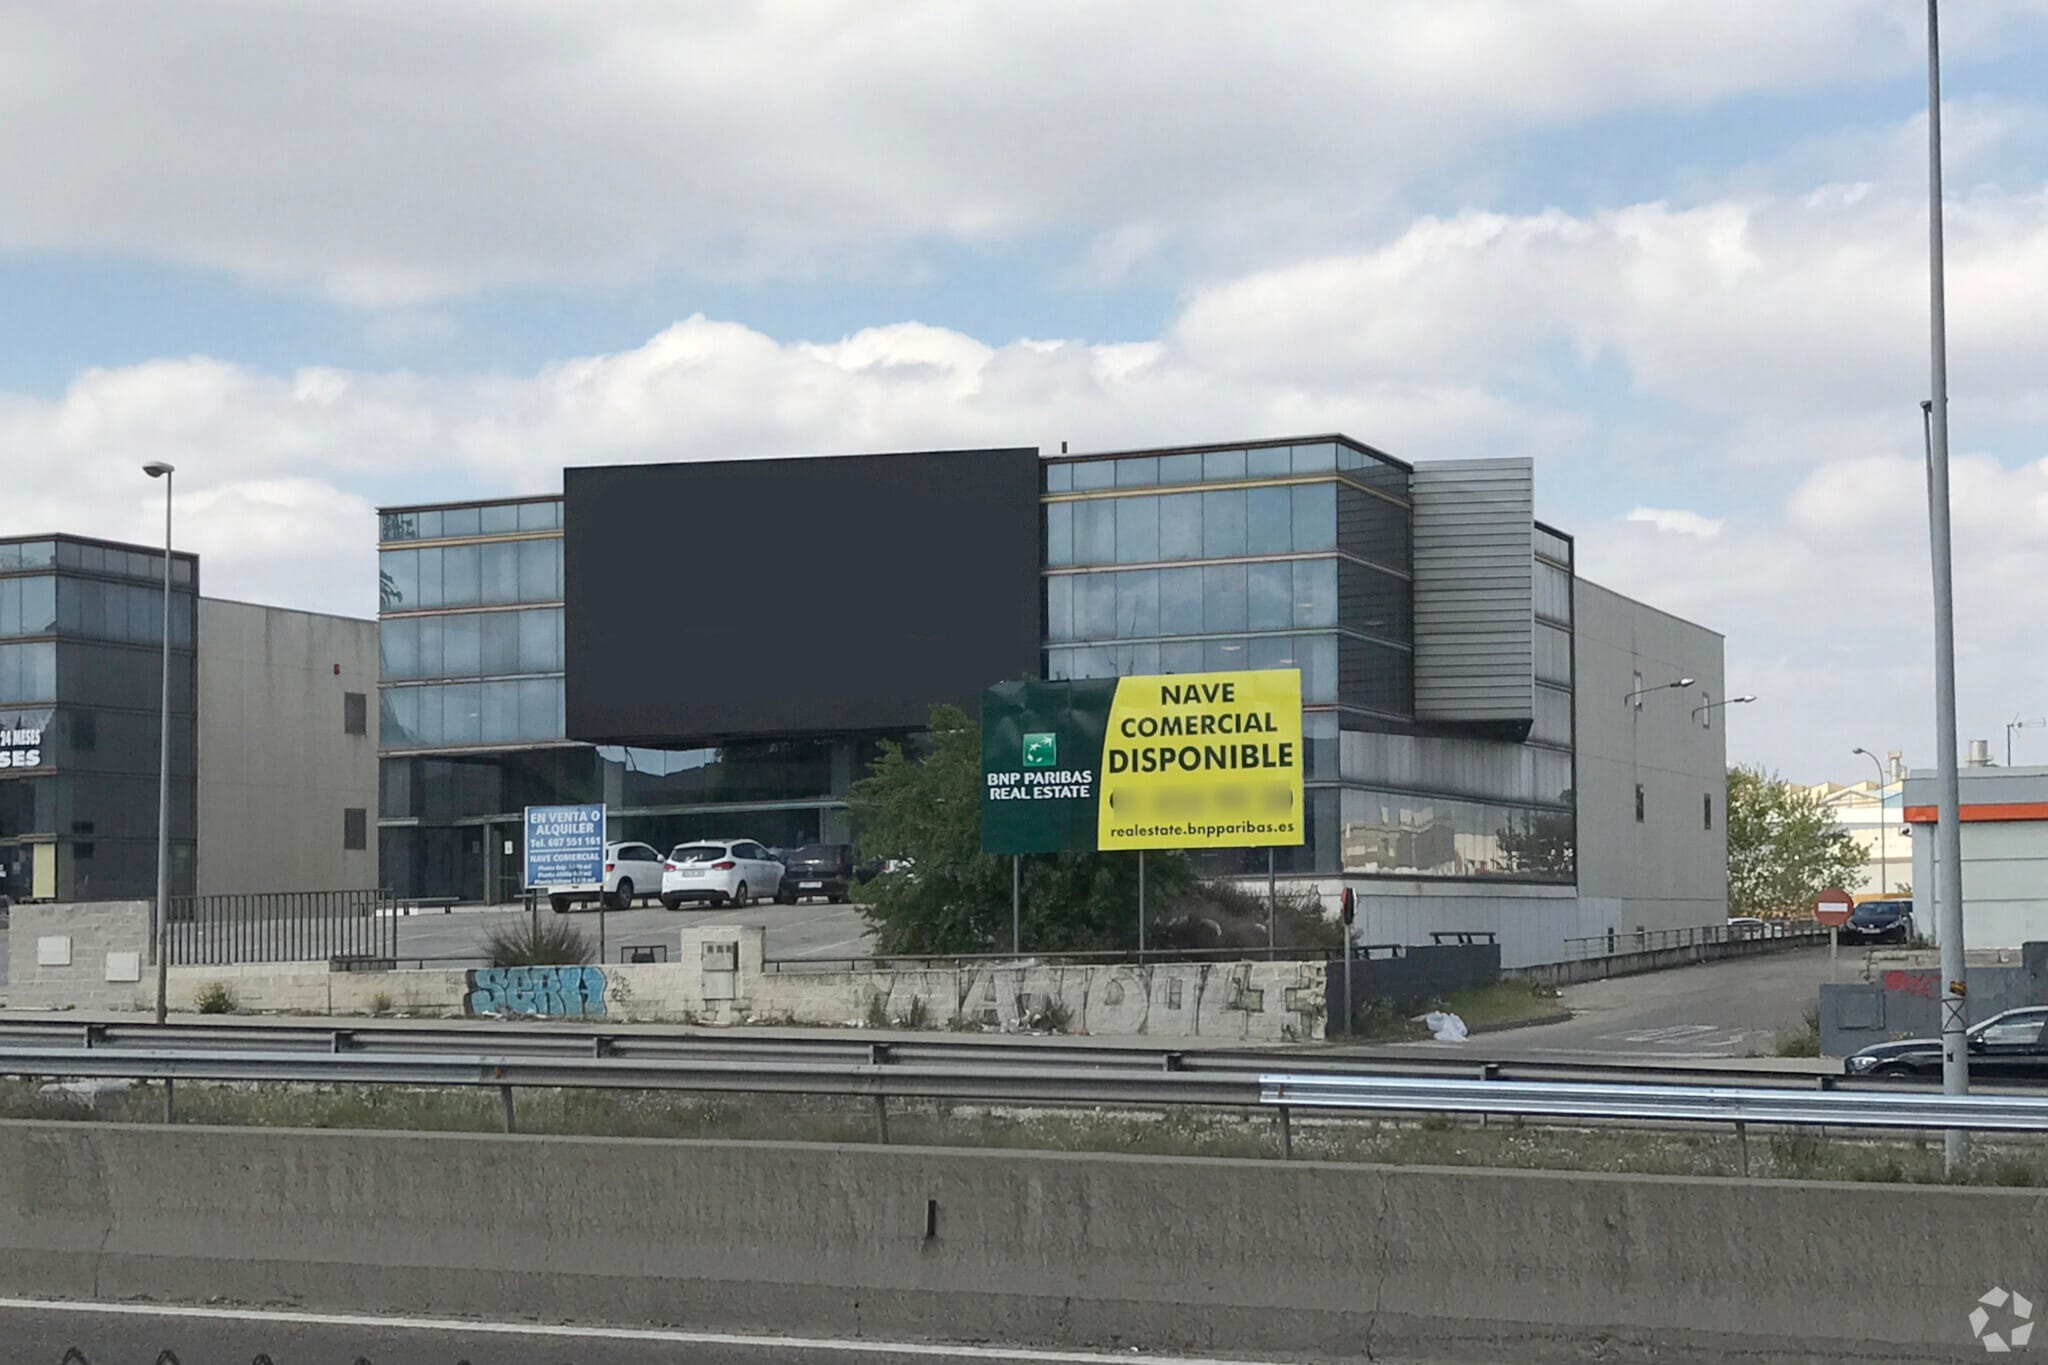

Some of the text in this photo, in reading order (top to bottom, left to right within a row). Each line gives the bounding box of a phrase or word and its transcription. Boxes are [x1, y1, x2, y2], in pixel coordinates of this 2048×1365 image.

[1160, 682, 1235, 706] NAVE
[1120, 711, 1278, 738] COMERCIAL
[13, 728, 41, 746] MESES
[1108, 742, 1294, 774] DISPONIBLE
[987, 769, 1093, 787] BNP PARIBAS
[989, 784, 1091, 801] REAL ESTATE
[530, 810, 601, 824] EN VENTA O
[535, 822, 594, 836] ALQUILER
[1110, 820, 1295, 838] realestate.bnpparibas.es
[530, 838, 546, 848] Tel.
[530, 852, 600, 863] NAVE COMERCIAL
